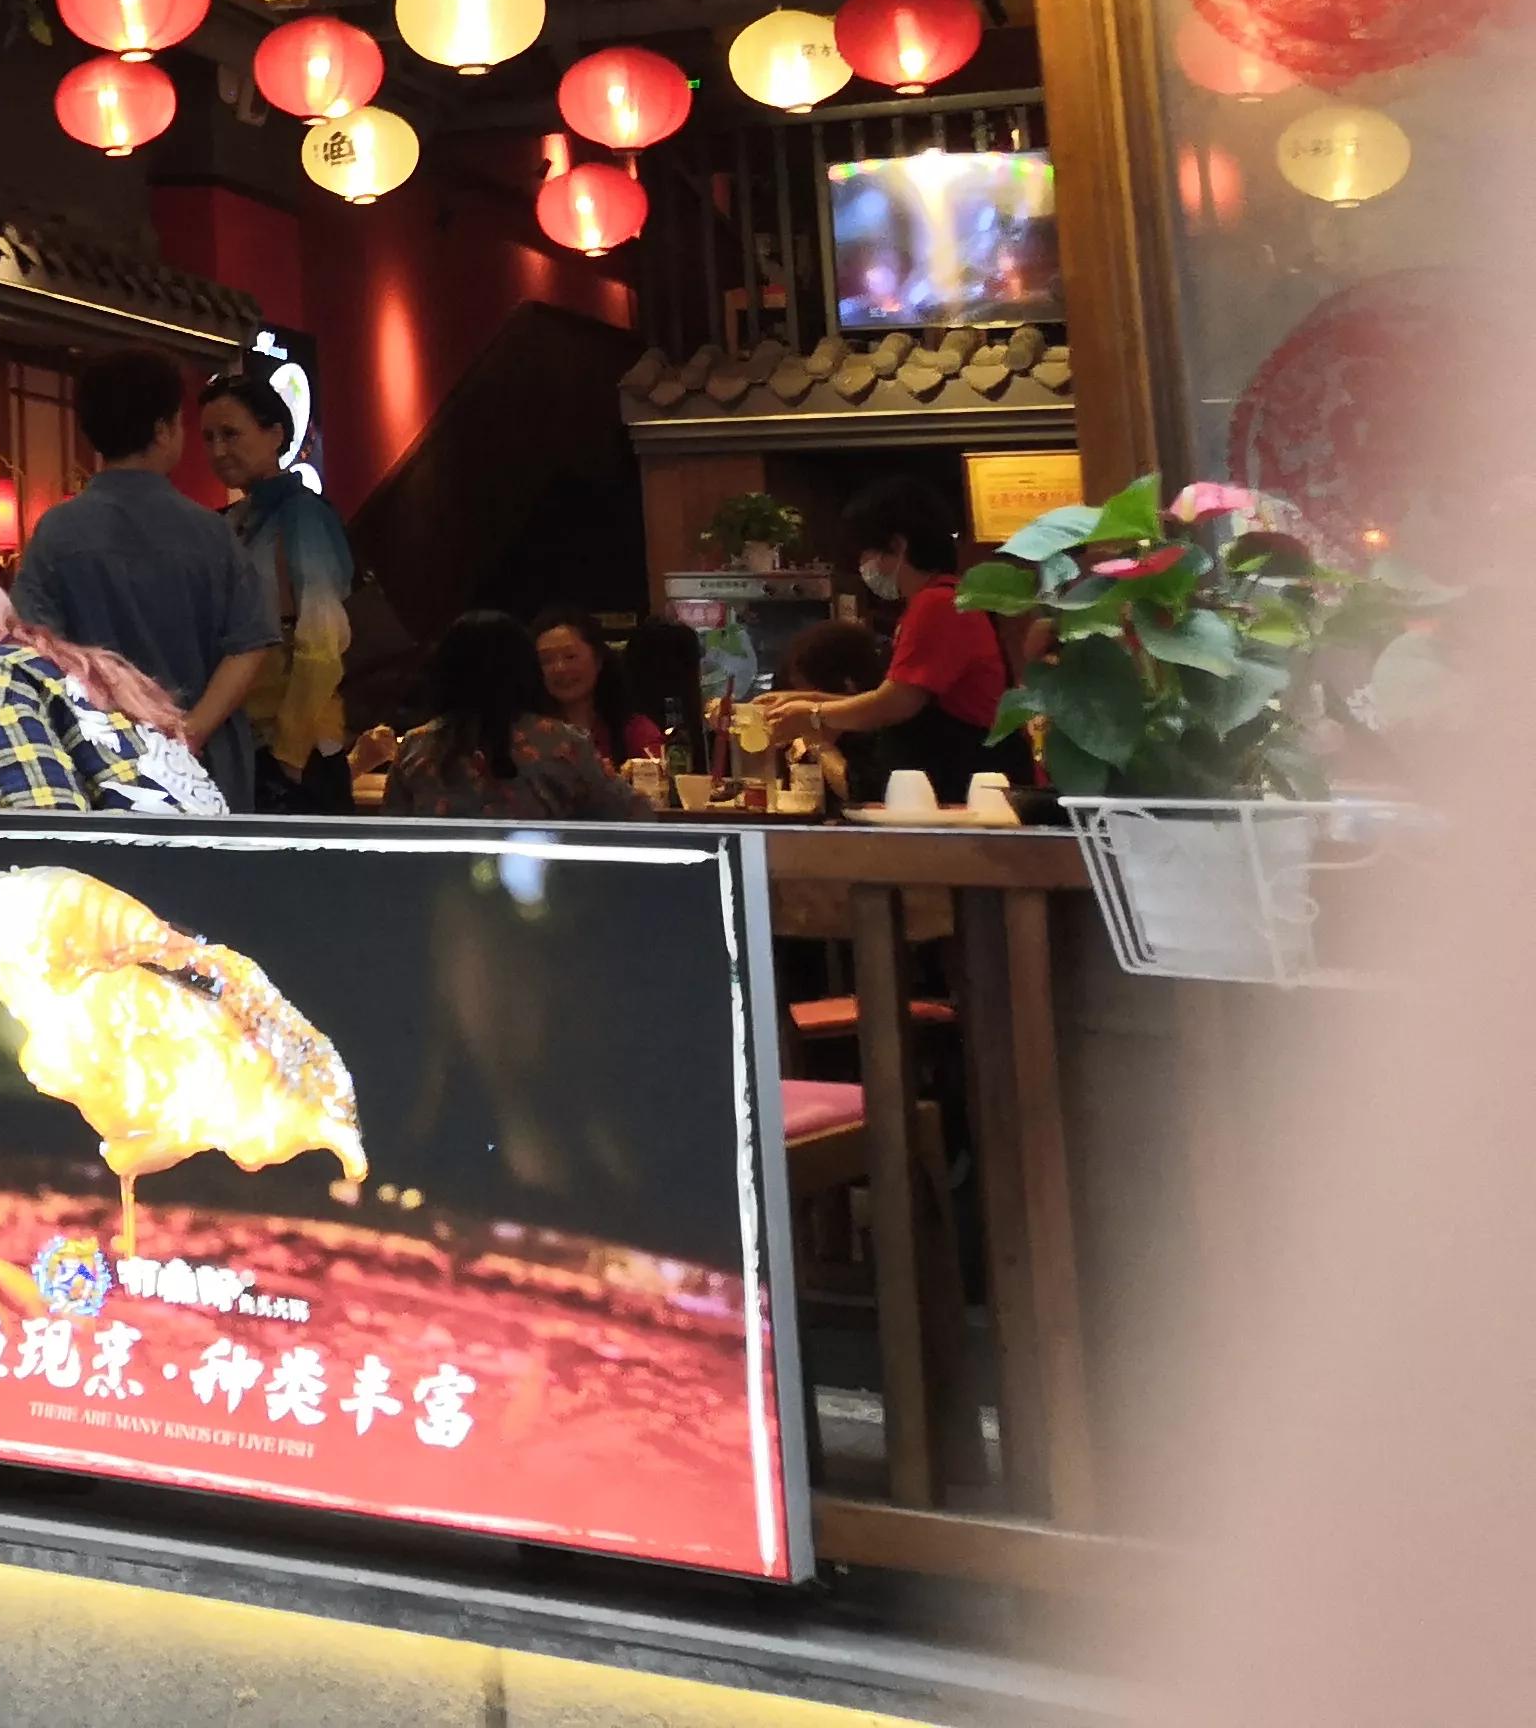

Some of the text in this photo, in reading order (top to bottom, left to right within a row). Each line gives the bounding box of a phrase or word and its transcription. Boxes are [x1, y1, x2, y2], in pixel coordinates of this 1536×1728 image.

[29, 1401, 315, 1459] THERE ARE MANY KINDS OF LIVE FISH
